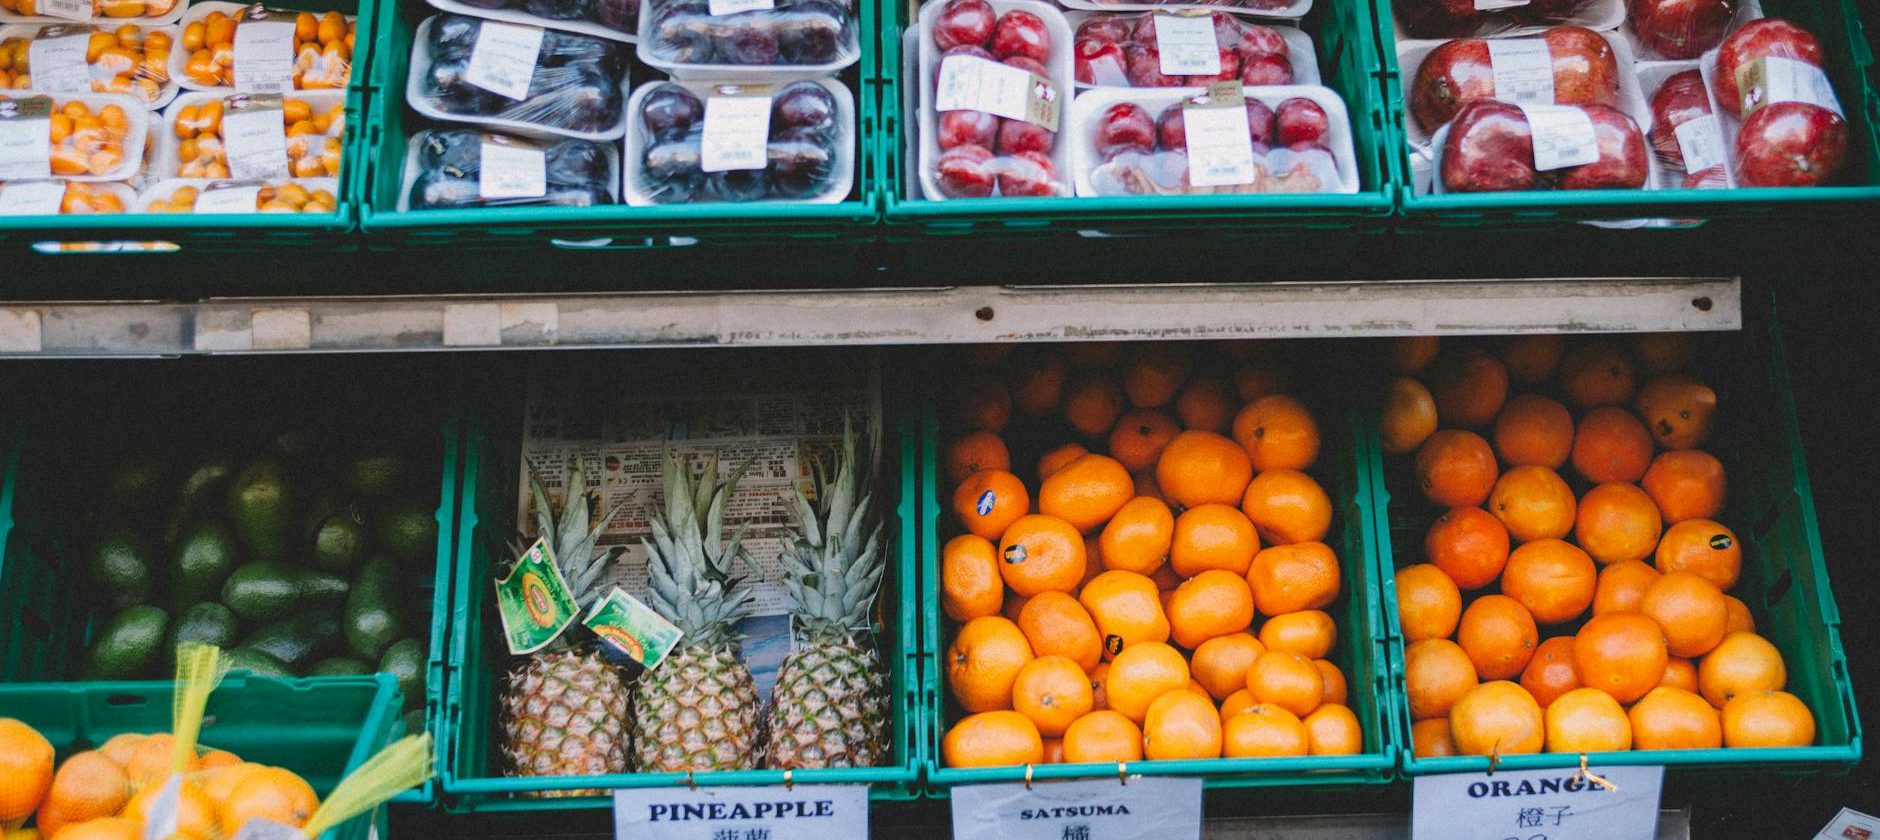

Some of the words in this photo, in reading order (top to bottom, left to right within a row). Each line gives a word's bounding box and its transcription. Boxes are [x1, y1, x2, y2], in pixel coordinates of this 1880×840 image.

[1467, 774, 1607, 798] ORANGE
[648, 800, 834, 821] PINEAPPLE
[1020, 804, 1131, 820] SATSUMA
[1516, 805, 1575, 828] 橙子
